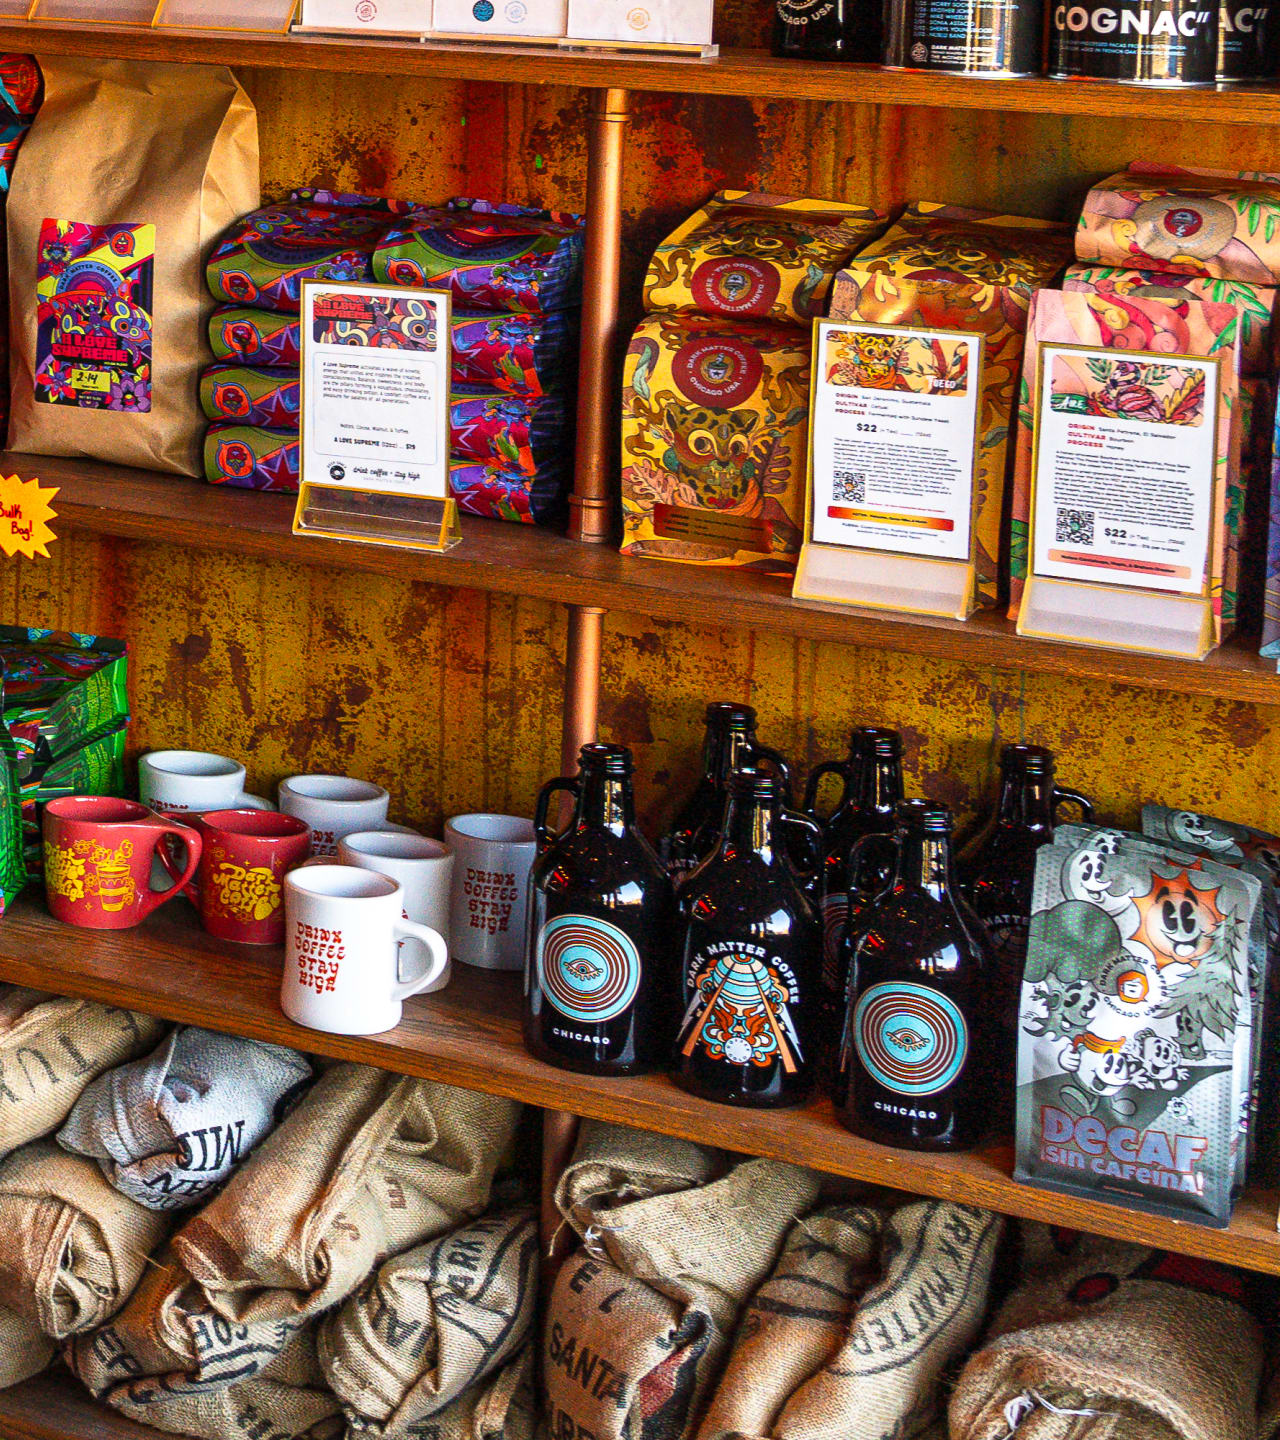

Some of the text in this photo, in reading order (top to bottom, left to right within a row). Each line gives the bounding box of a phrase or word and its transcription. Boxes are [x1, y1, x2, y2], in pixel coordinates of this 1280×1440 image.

[811, 3, 834, 21] USA
[1055, 5, 1211, 37] COGNAC"
[75, 334, 117, 348] LOVE
[51, 344, 128, 361] SUPREME
[690, 376, 740, 396] CHICAGO USA
[835, 400, 867, 408] CULTIVAR
[835, 408, 865, 416] PROCESS
[856, 422, 877, 433] $22
[1068, 422, 1095, 430] ORIGIN
[1067, 431, 1106, 441] CULTIVAR
[1067, 439, 1104, 448] PROCESS
[11, 518, 34, 541] Bag!
[1104, 528, 1127, 539] $22
[467, 867, 516, 886] DRINK
[464, 882, 519, 902] COFFEE
[468, 898, 511, 918] STAY
[296, 921, 342, 941] DRINK
[295, 939, 346, 961] COFFEE
[297, 955, 339, 978] STAY
[1111, 952, 1150, 970] MATTER
[686, 940, 800, 1004] DARK MATTER COFFEE
[299, 970, 336, 994] HIGH
[553, 1026, 610, 1045] CHICAGO
[873, 1100, 938, 1120] CHICAGO
